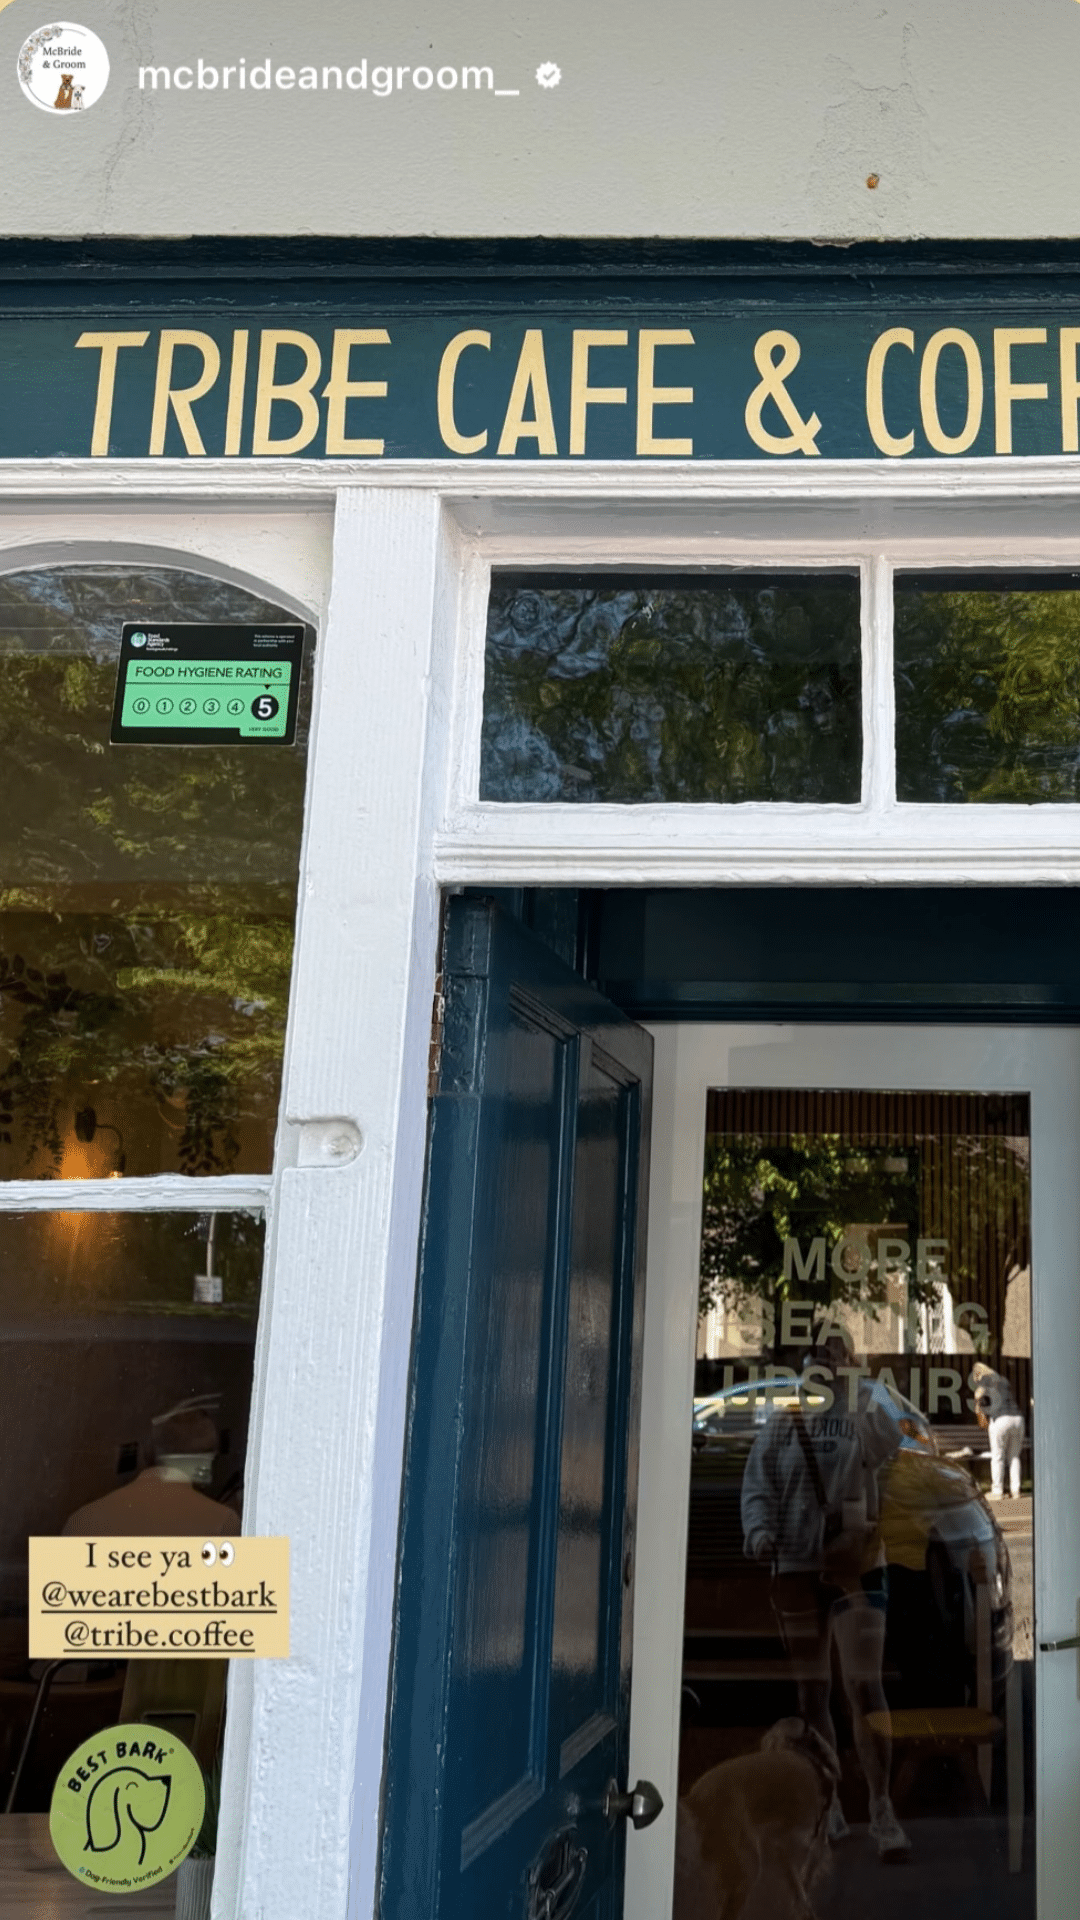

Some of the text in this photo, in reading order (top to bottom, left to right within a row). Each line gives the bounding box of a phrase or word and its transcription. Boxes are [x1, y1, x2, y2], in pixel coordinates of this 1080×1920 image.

[74, 328, 391, 457] TRIBE
[437, 328, 696, 455] CAFE
[744, 329, 823, 456] &
[135, 666, 283, 679] FOOD HYGIENE RATING
[257, 697, 273, 718] 5
[783, 1237, 949, 1282] MORE
[68, 1741, 168, 1793] BEST BARK
[133, 1866, 163, 1883] Verified
